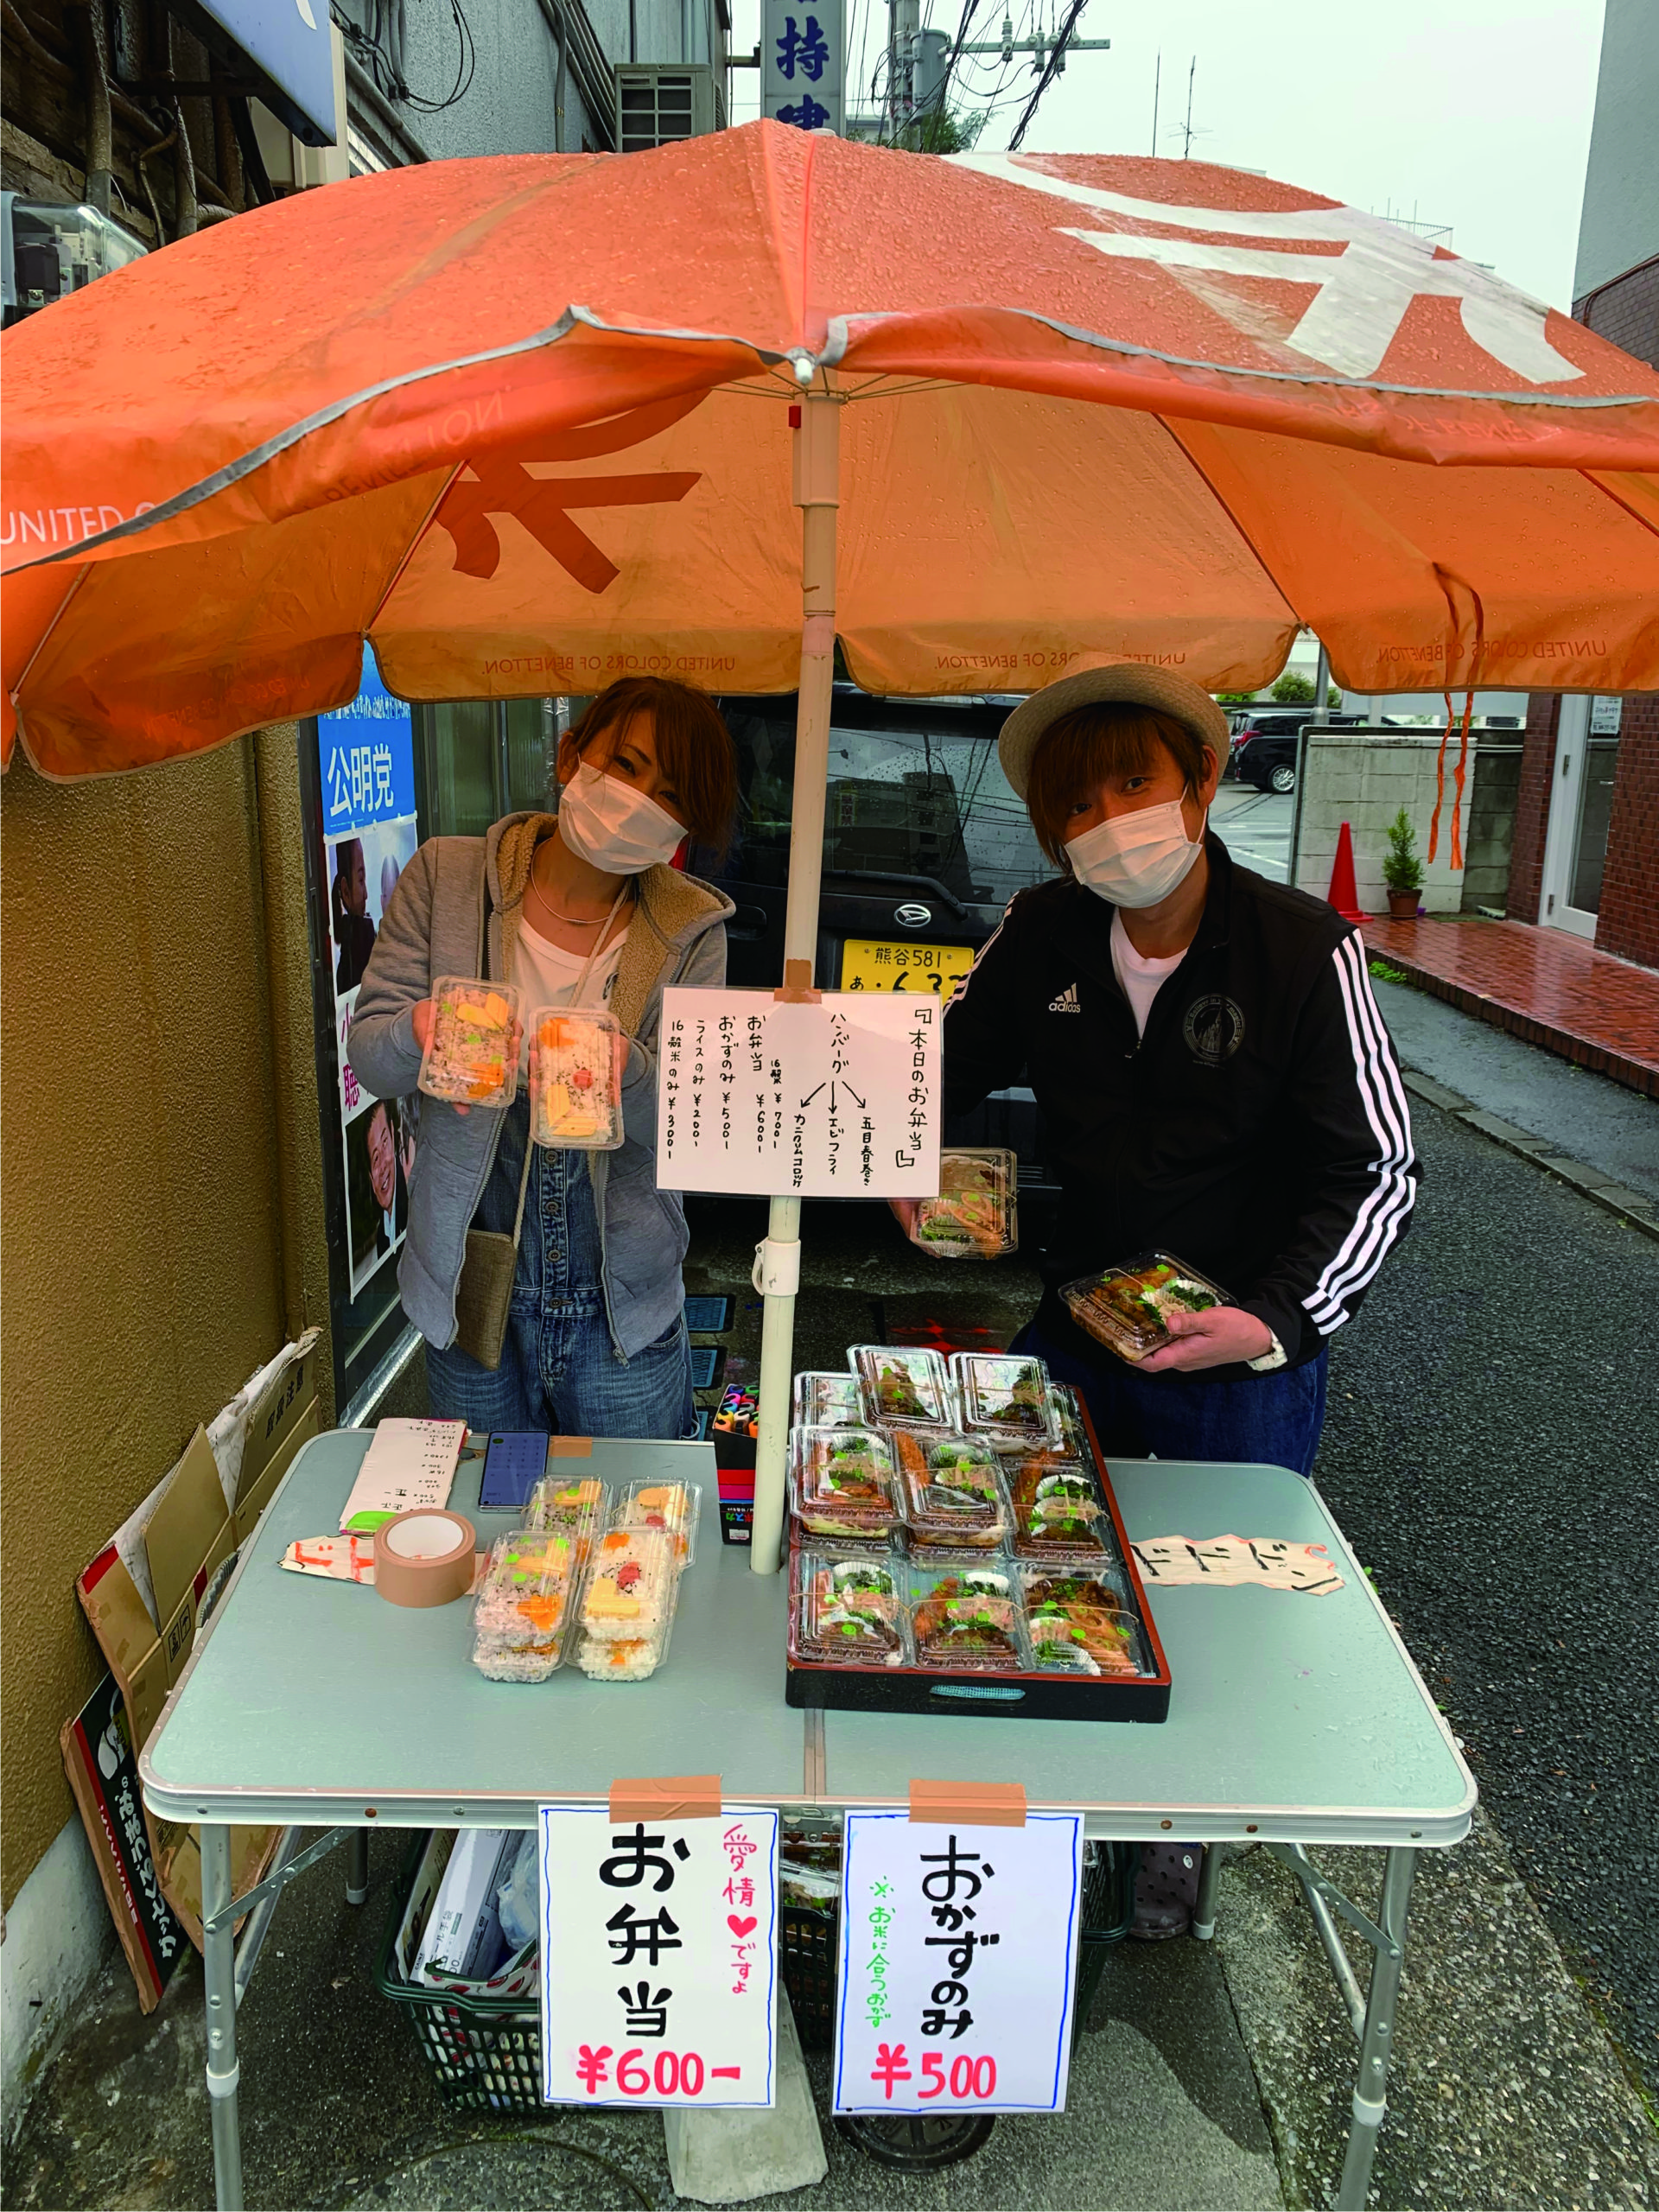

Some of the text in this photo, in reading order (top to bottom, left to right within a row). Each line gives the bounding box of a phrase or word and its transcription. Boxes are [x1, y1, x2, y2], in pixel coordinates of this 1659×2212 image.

[0, 505, 125, 545] UNITED
[327, 743, 394, 817] 公明党
[874, 947, 941, 968] 熊谷581
[1048, 1001, 1081, 1013] adidas
[692, 1020, 706, 1085] ライスのみ
[718, 1016, 739, 1084] おかずのみ
[747, 1015, 766, 1071] お弁当
[830, 1014, 850, 1074] ハンバーグ
[895, 1009, 932, 1168] 『本日のお弁当』
[828, 1118, 844, 1175] エビフライ
[860, 1116, 876, 1186] 五目春巻き
[599, 1822, 691, 2037] お弁当
[920, 1834, 1001, 2040] おかずのみ
[870, 2043, 997, 2101] ¥500
